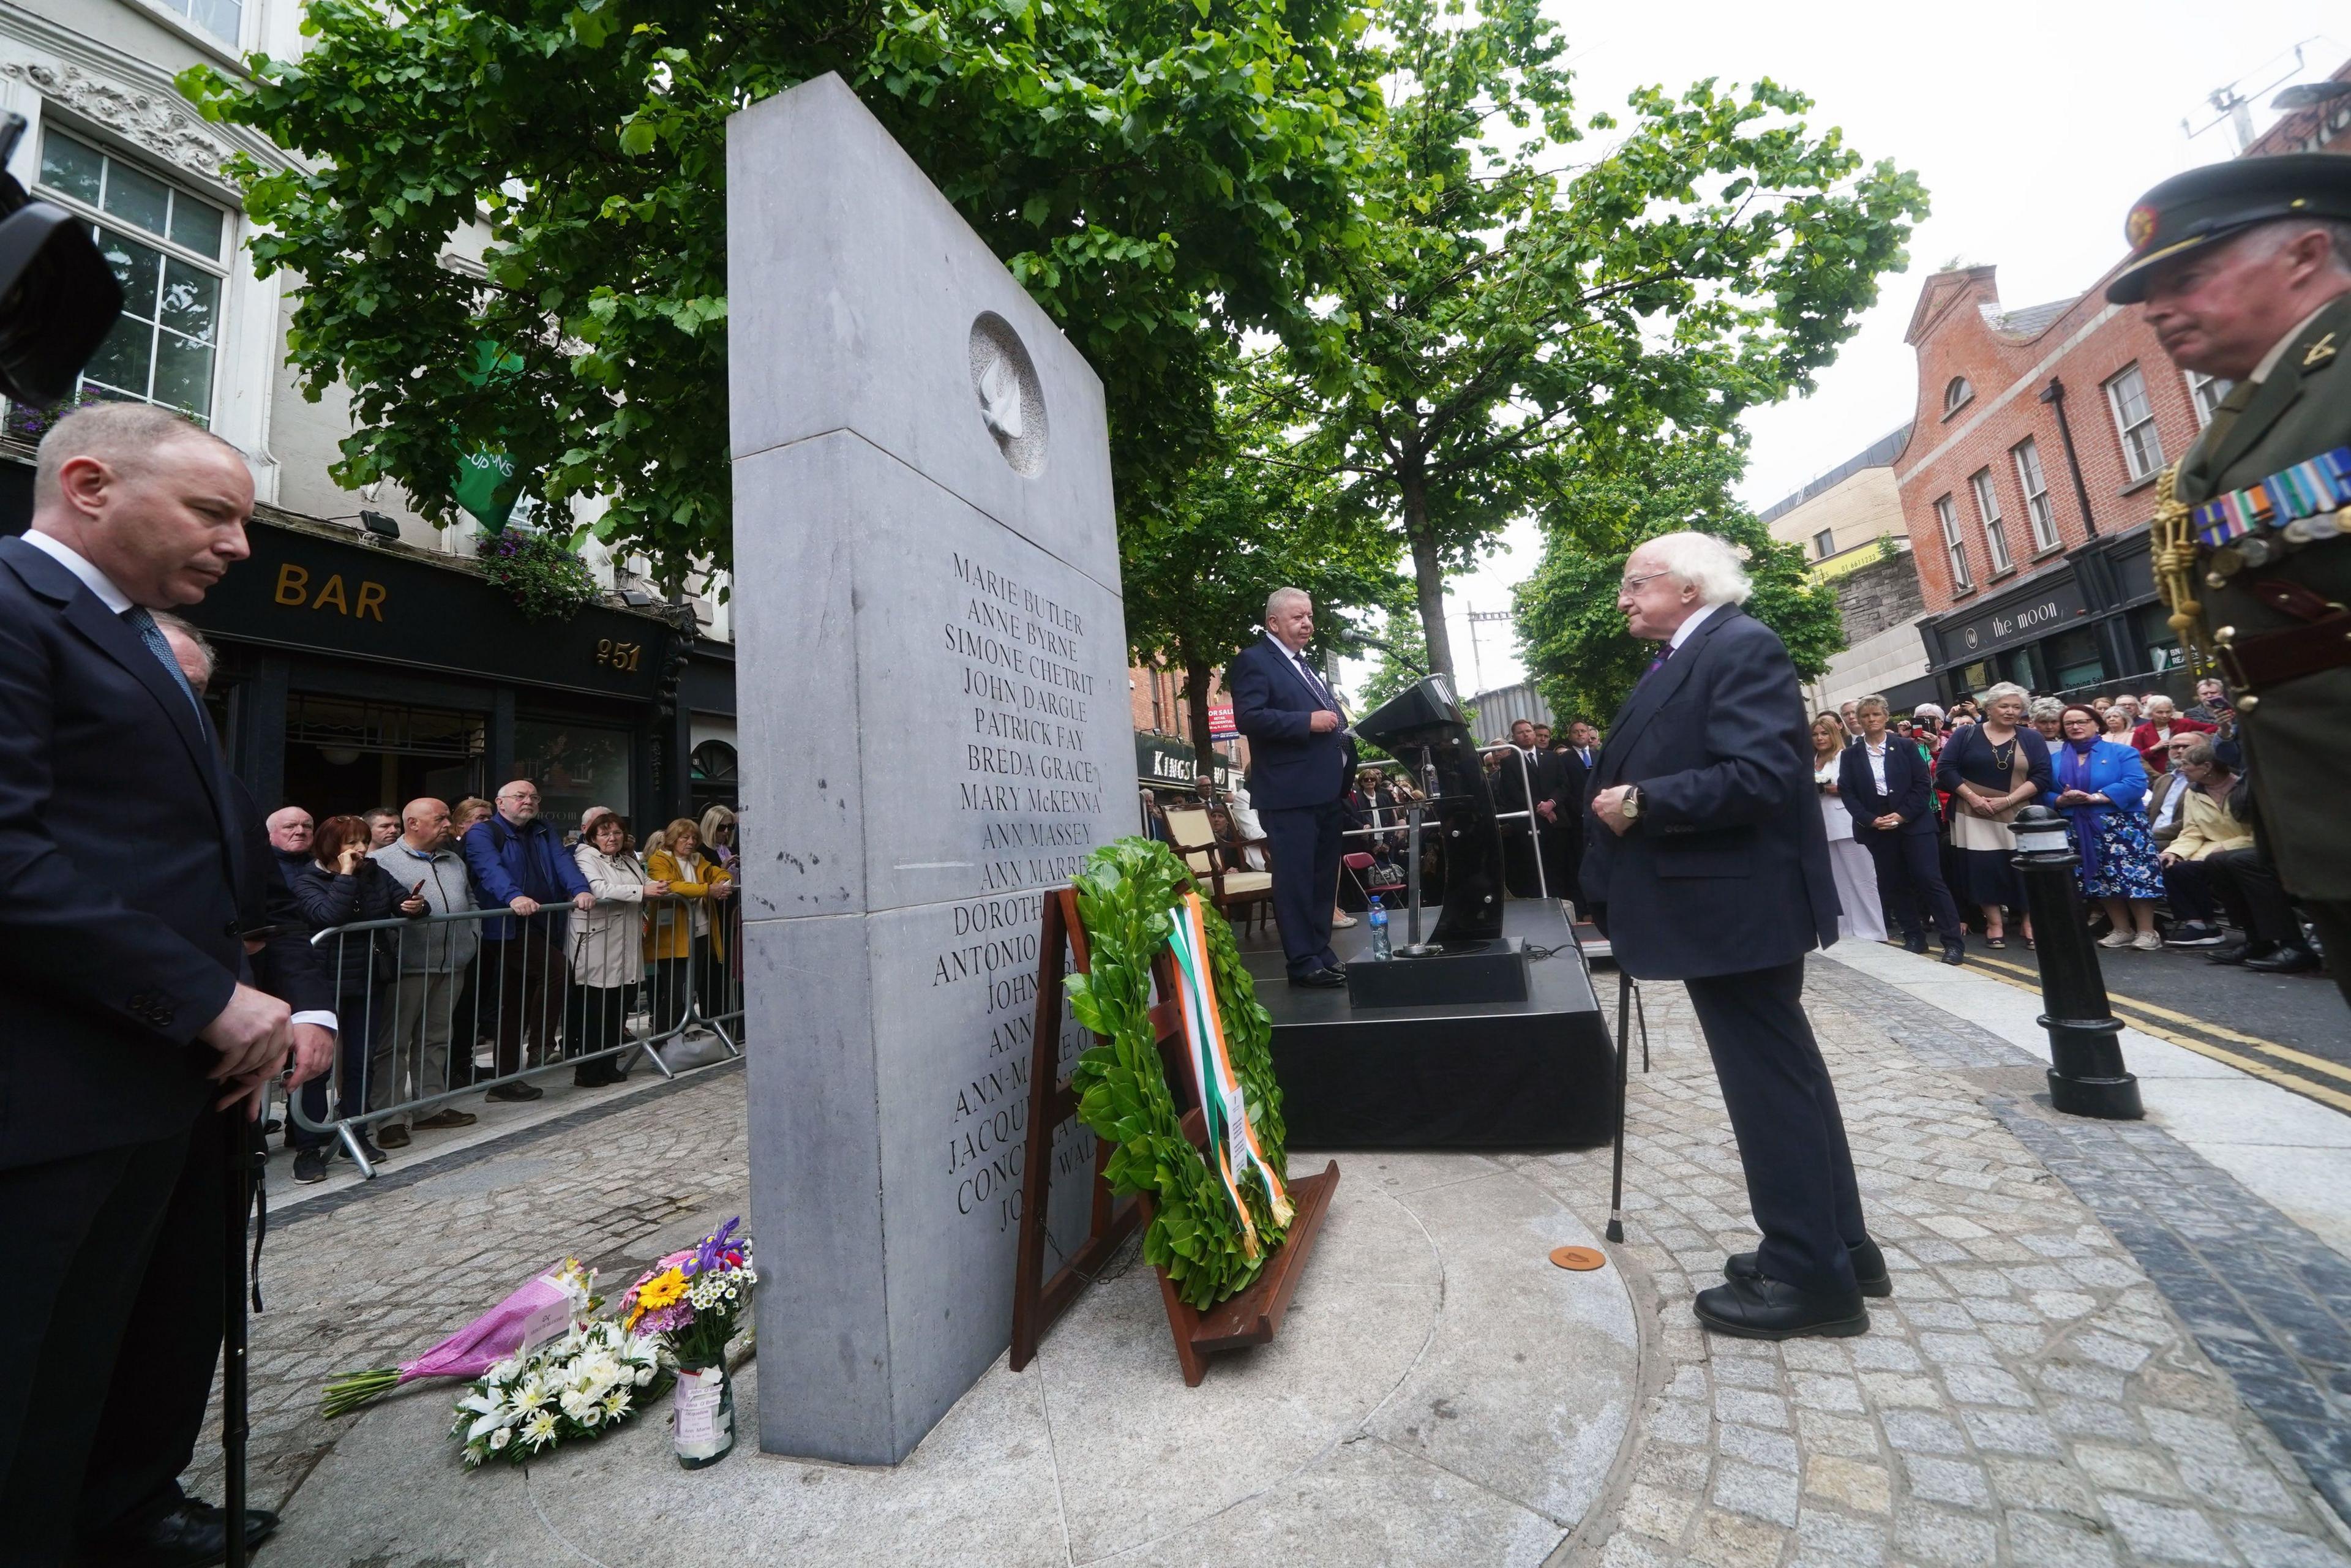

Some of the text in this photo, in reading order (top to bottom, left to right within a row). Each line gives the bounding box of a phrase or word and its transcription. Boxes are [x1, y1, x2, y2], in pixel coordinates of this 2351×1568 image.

[1851, 553, 1876, 569] 6611233
[275, 563, 386, 623] BAR
[953, 552, 1083, 637] MARIE BUTLER
[968, 598, 1078, 662] ANNE BYRNE
[1993, 602, 2057, 637] the moon
[945, 623, 1093, 696] SIMONE CHETRIT
[2169, 647, 2184, 657] BN
[964, 667, 1087, 723] JOHN DARGLE
[975, 708, 1083, 751] PATRICK FAY
[967, 744, 1093, 783] BREDA GRACE
[1154, 751, 1190, 781] KINGS
[961, 783, 1101, 814] MARY McKENNA
[983, 823, 1091, 850] ANN MASSEY
[981, 855, 1089, 890] ANN MARRE
[953, 896, 1043, 936] DOROTH
[932, 934, 1035, 987] ANTONIO
[989, 1013, 1032, 1058] ANN
[1001, 1133, 1097, 1232] JO WAL
